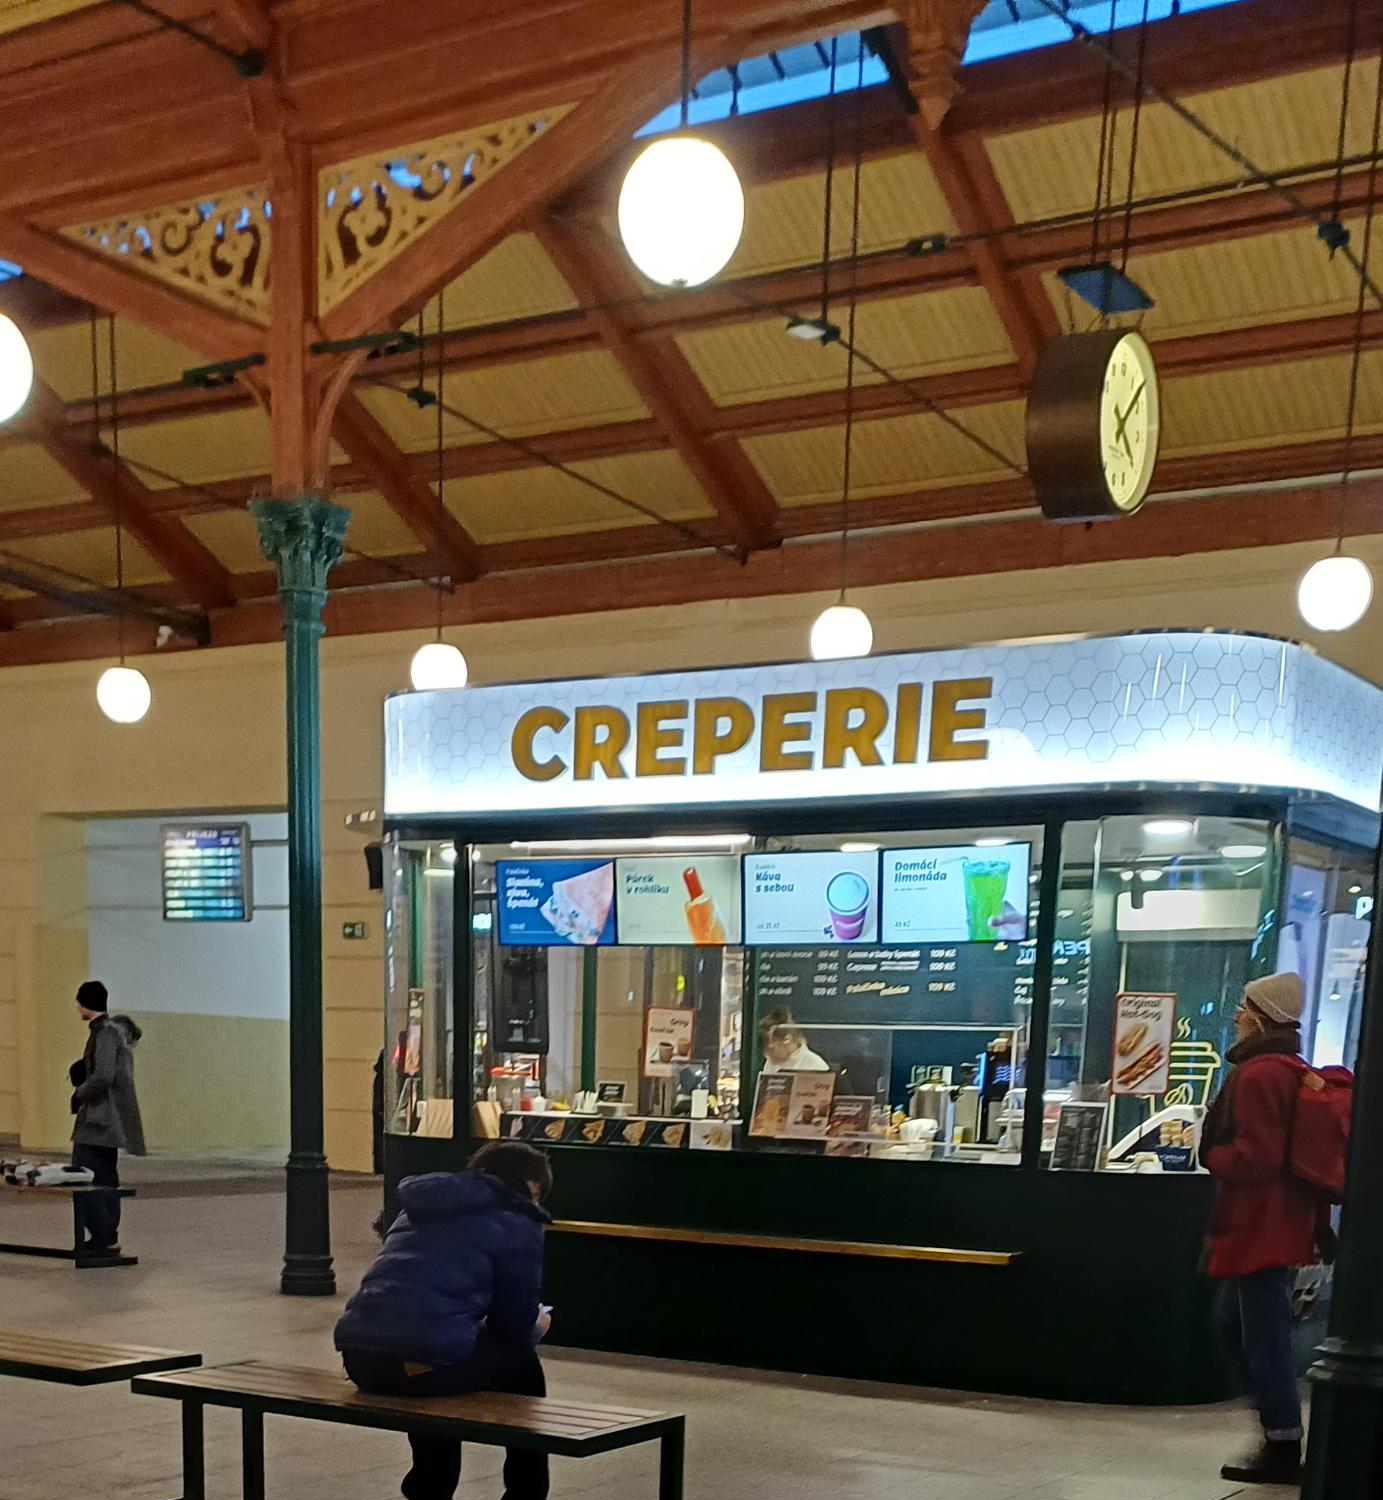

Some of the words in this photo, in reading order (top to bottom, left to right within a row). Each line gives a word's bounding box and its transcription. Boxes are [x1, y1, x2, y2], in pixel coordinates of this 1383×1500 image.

[511, 676, 994, 782] CREPERIE
[895, 858, 938, 871] Domácí
[756, 870, 782, 881] Káva
[894, 870, 948, 883] limonáda
[755, 884, 762, 893] s
[763, 883, 794, 893] sebou
